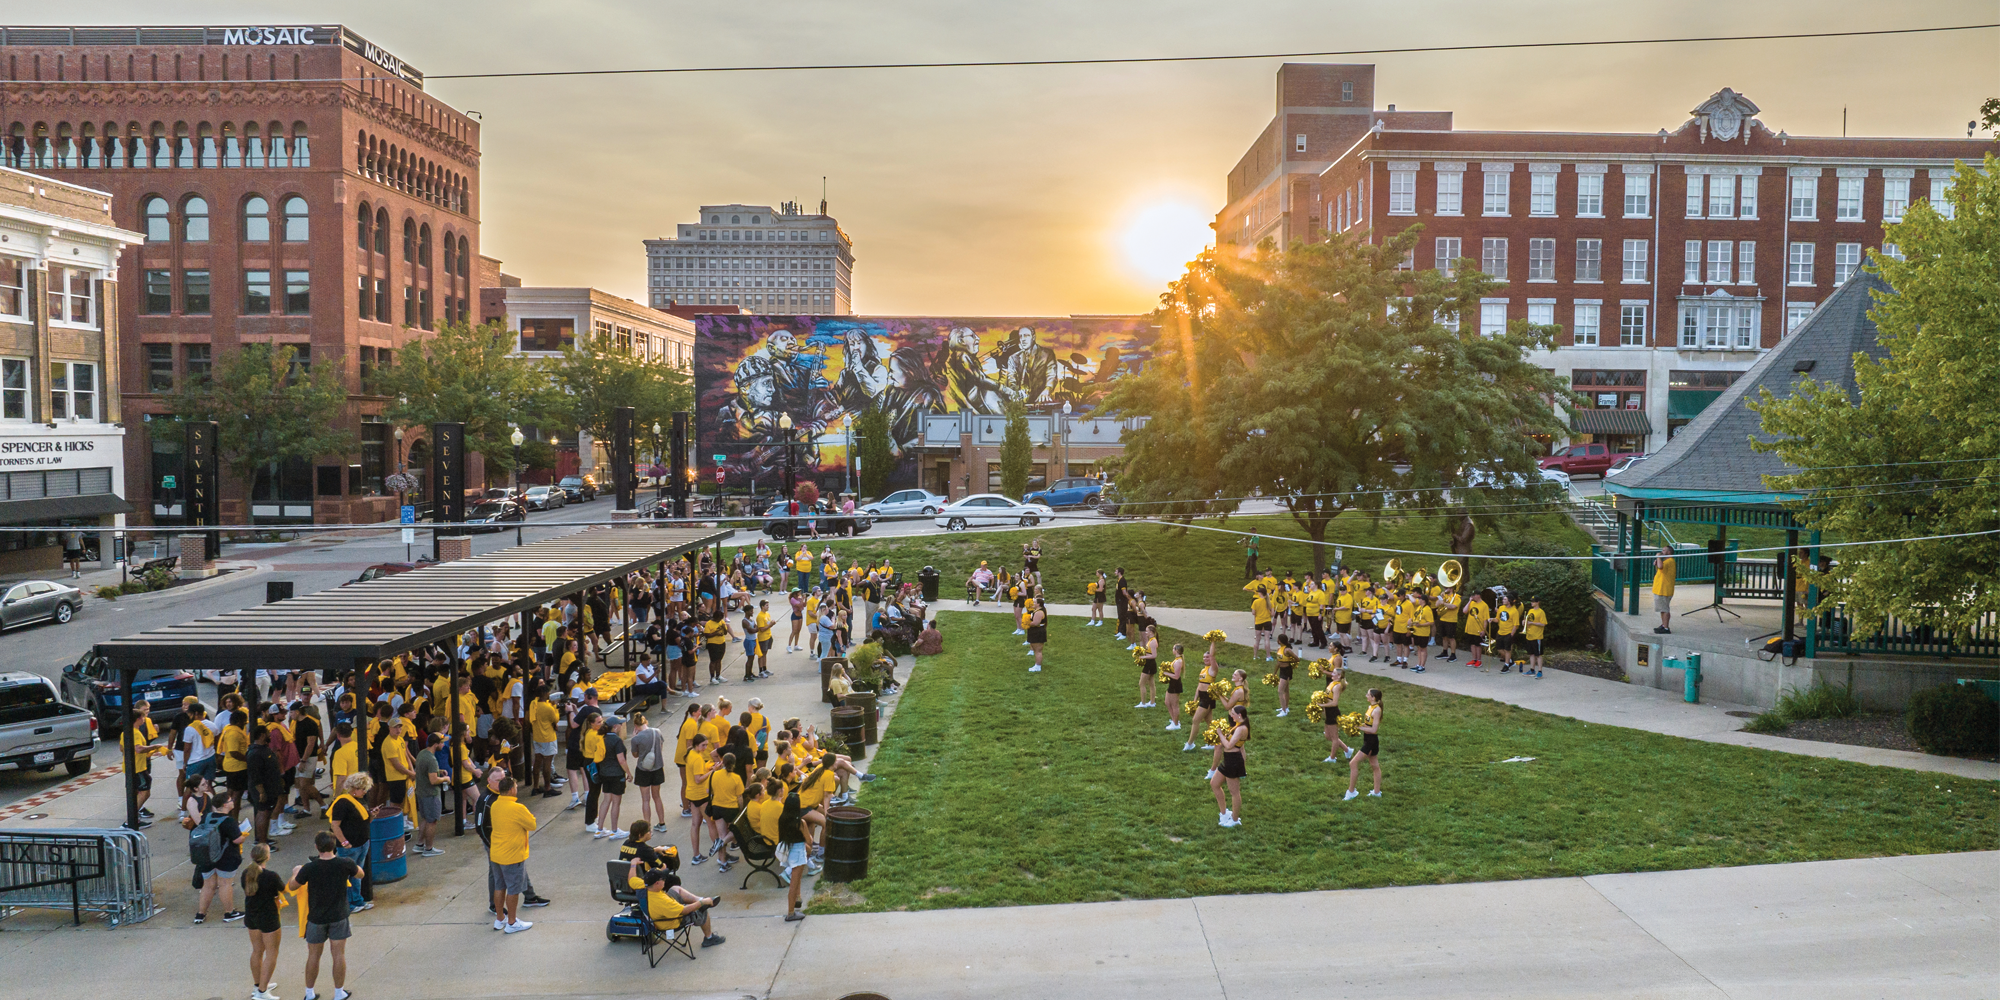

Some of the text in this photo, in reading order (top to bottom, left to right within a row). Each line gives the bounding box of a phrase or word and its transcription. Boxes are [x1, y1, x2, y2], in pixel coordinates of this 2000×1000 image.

[223, 27, 315, 45] MOSAIC
[364, 42, 405, 78] MOSAIC
[1, 441, 95, 453] SPENCER & HICKS
